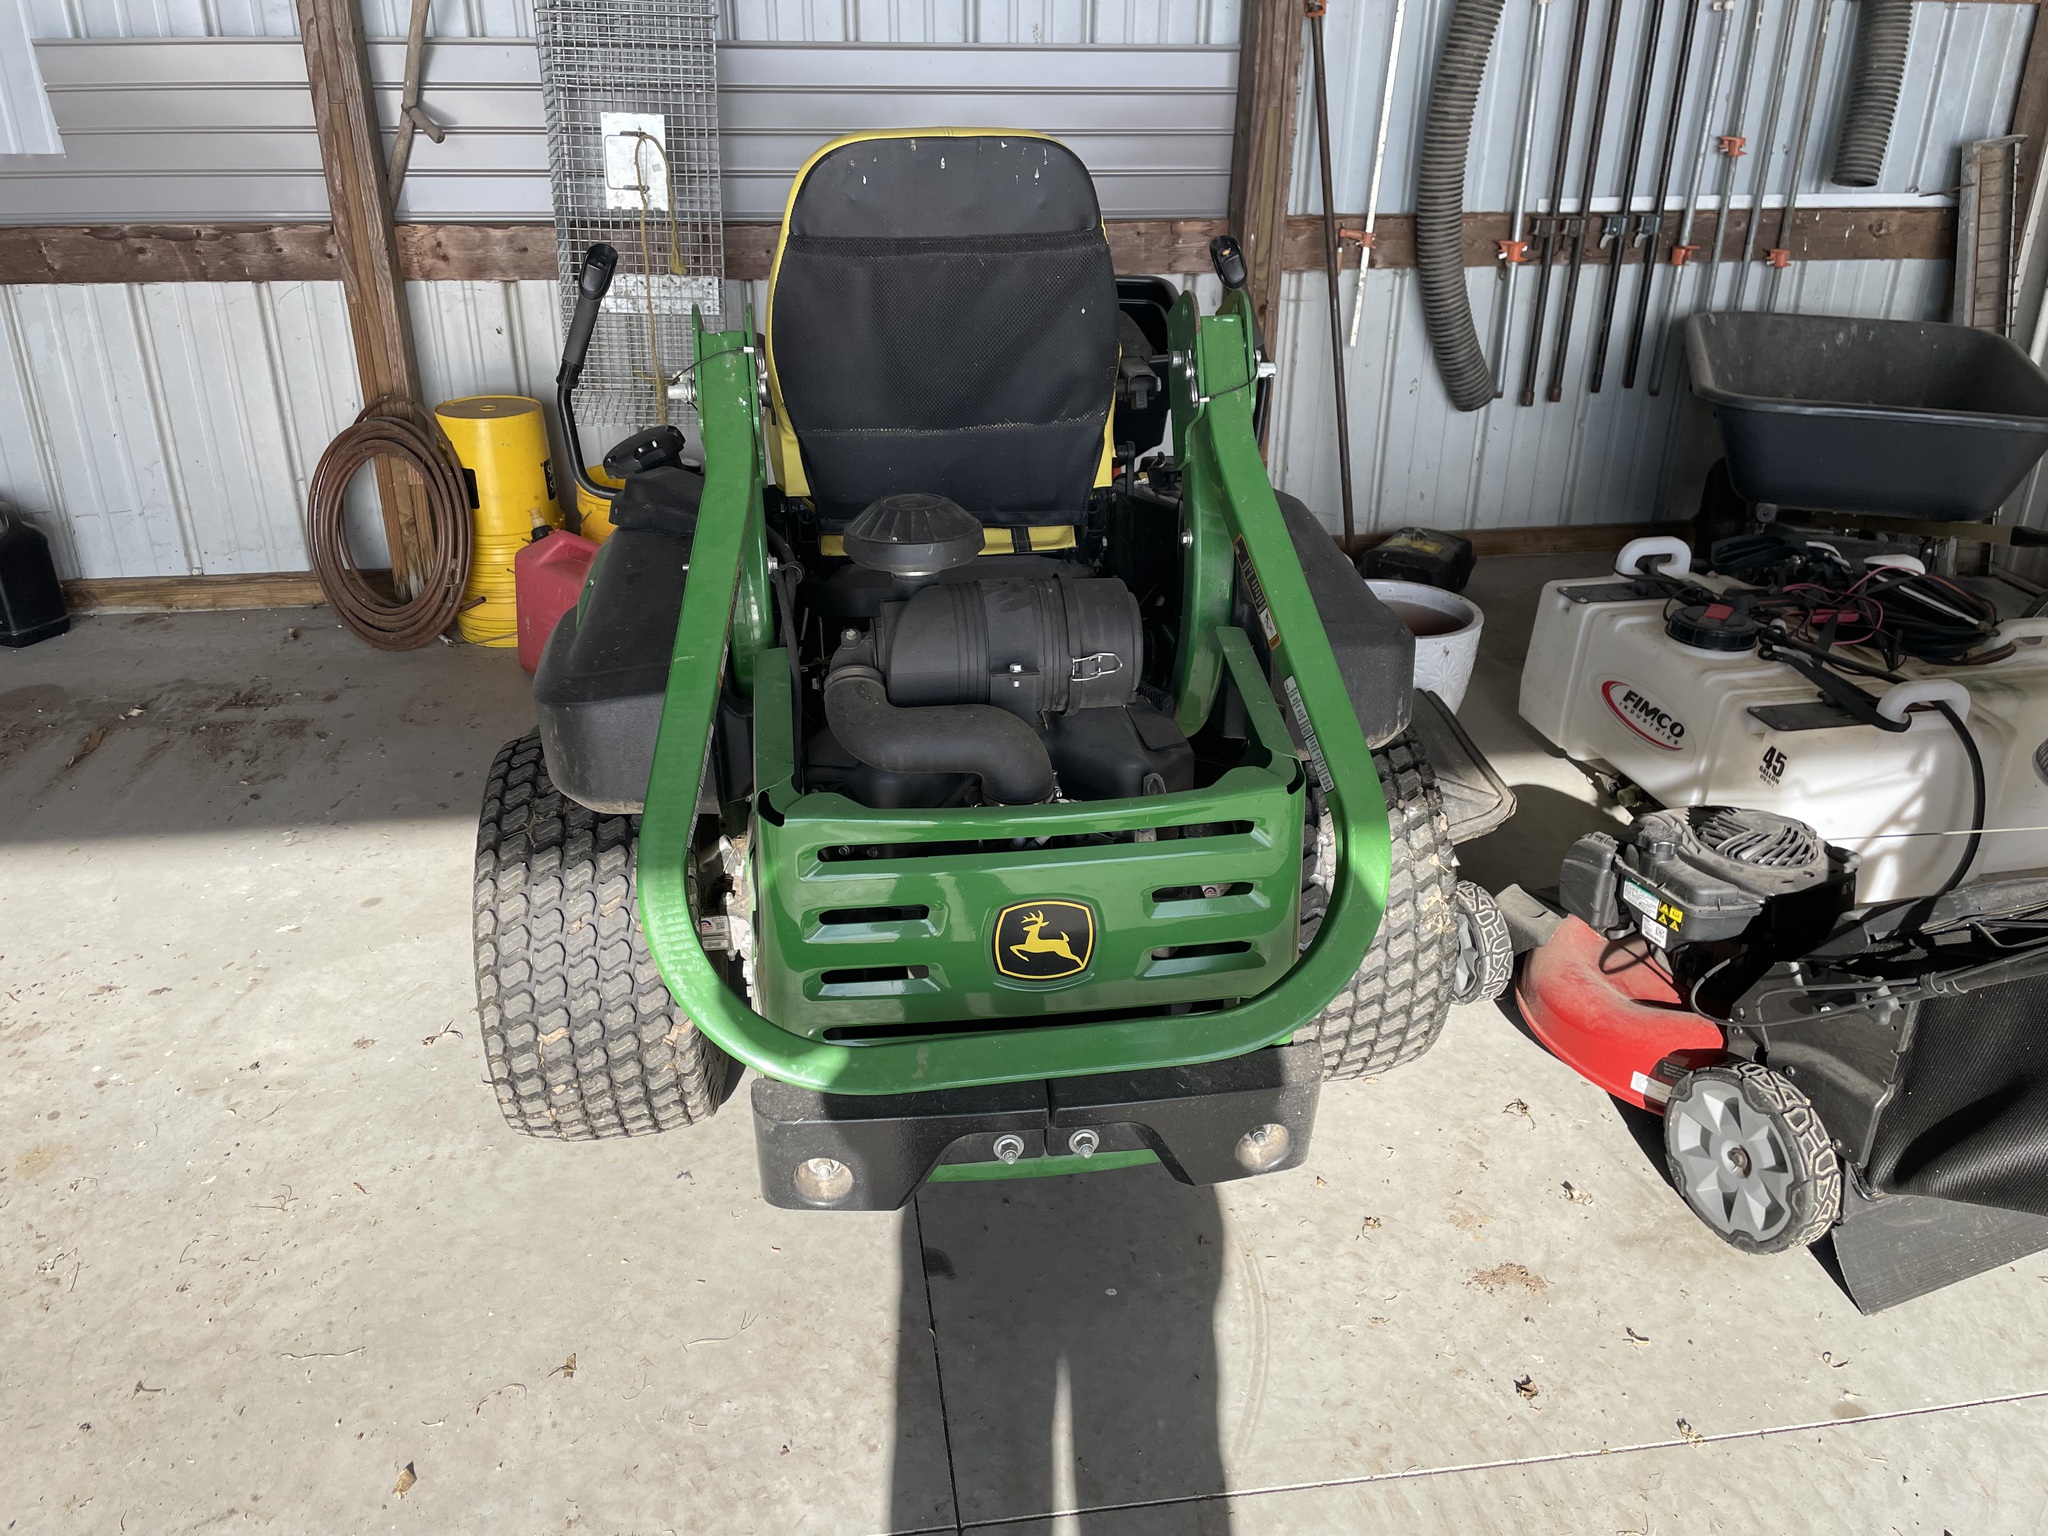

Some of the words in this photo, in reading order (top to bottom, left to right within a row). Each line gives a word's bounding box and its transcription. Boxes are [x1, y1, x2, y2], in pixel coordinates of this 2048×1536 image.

[1619, 702, 1679, 745] INDUSTRIES
[1623, 690, 1685, 738] FIMCO
[1759, 765, 1780, 785] GALLON
[1762, 746, 1787, 777] 45
